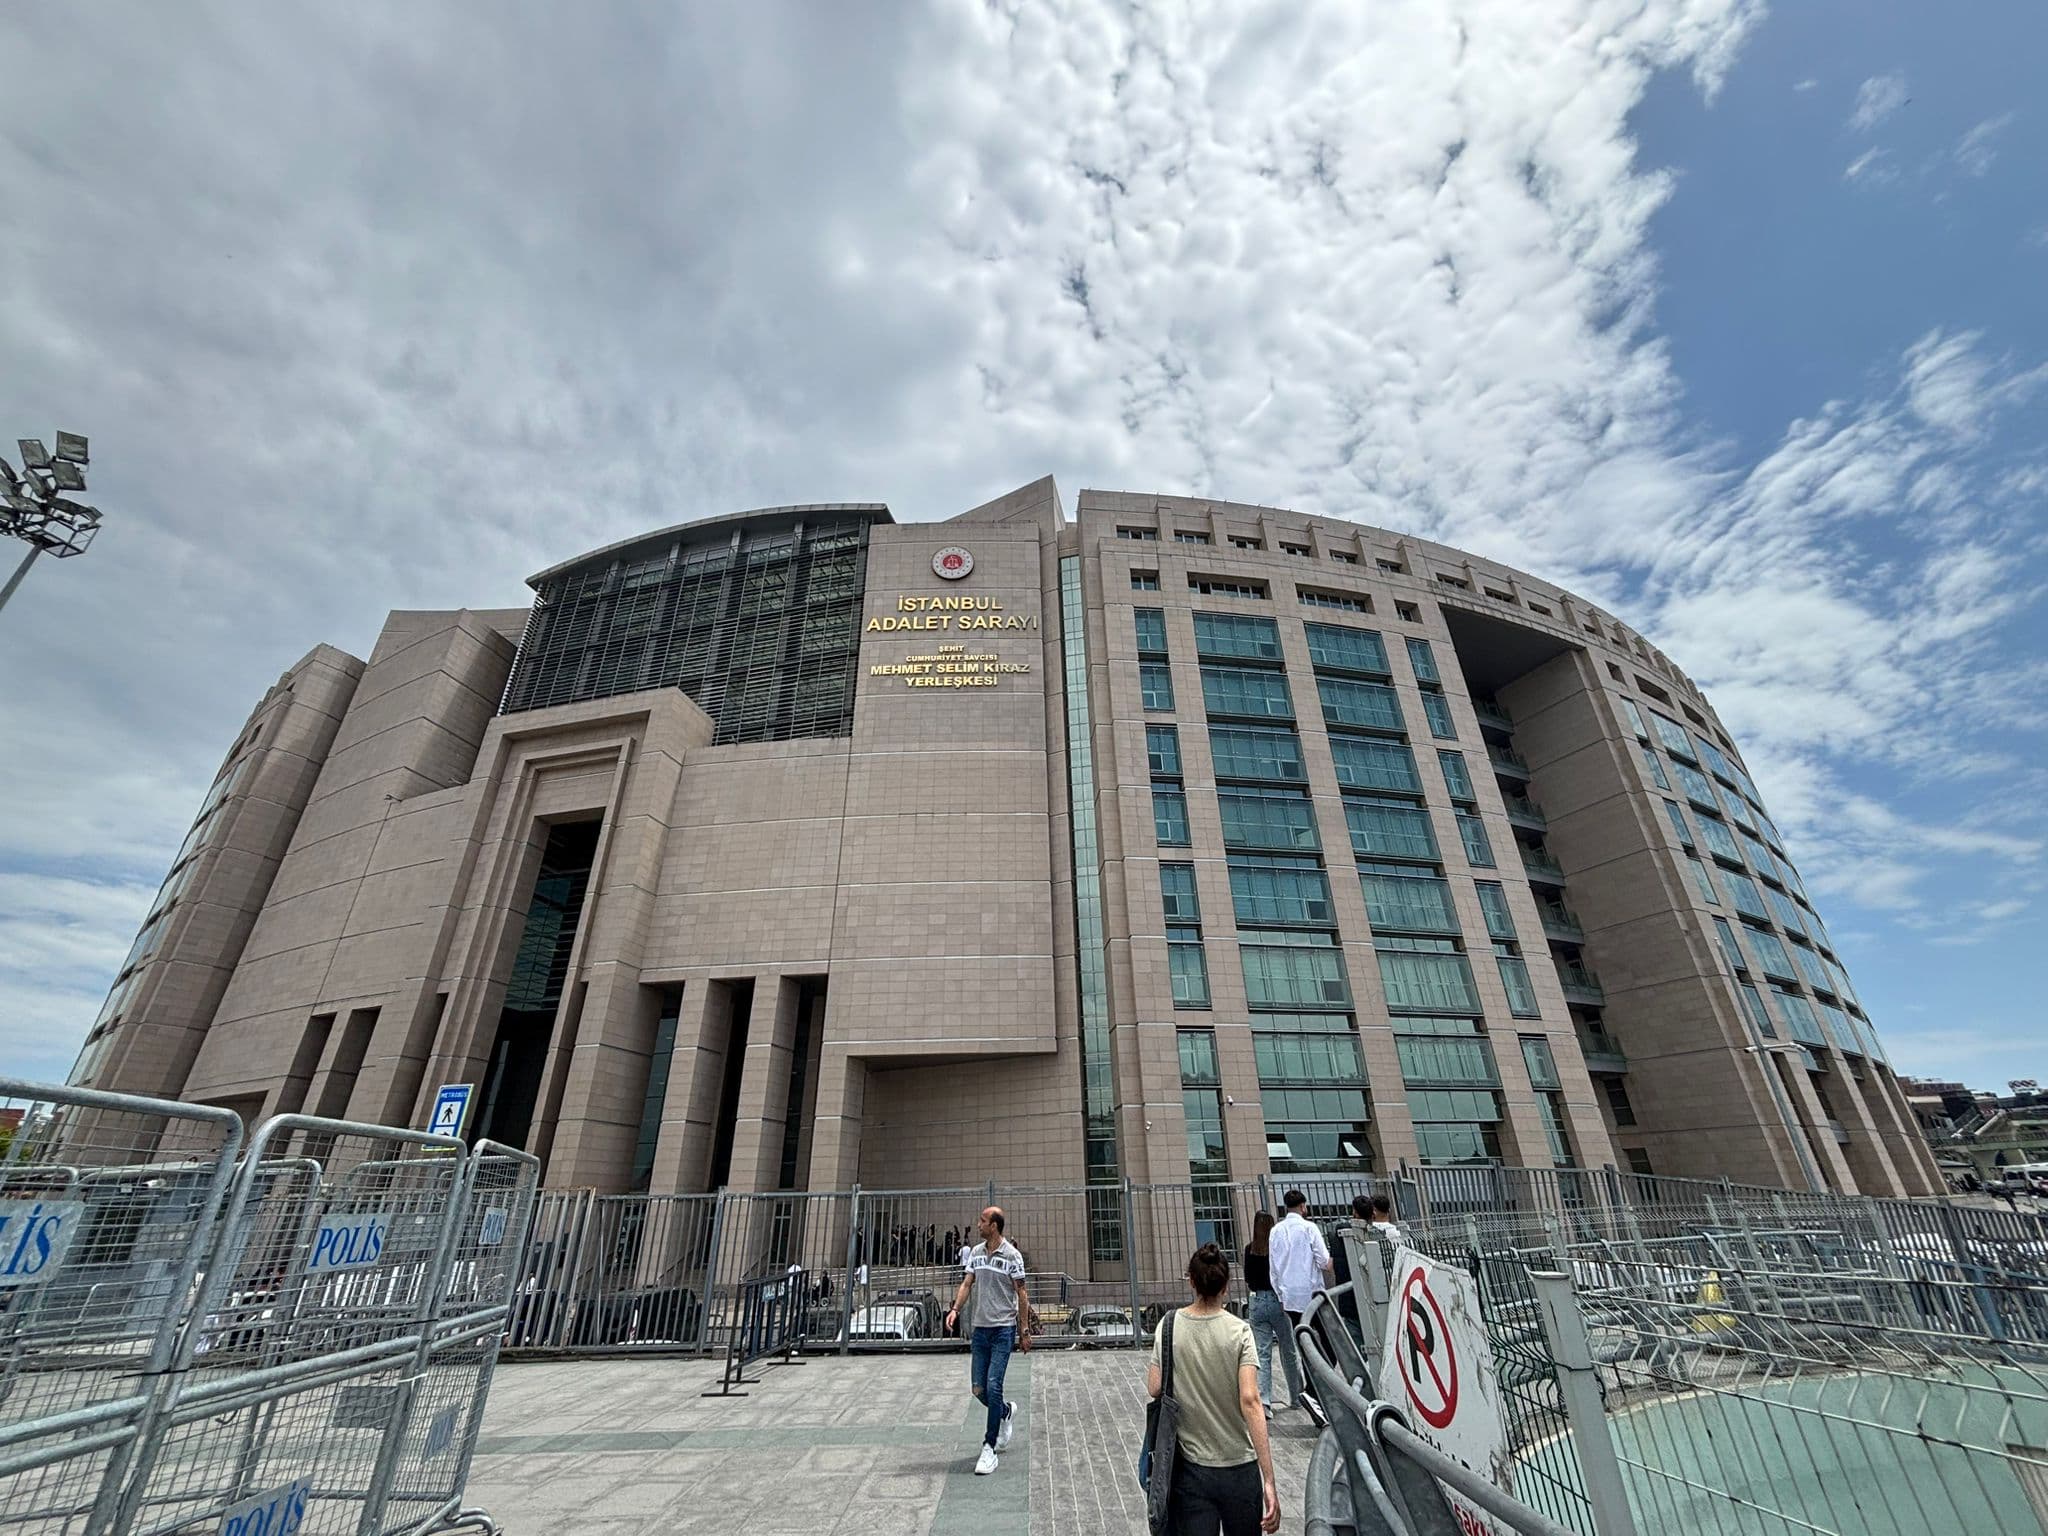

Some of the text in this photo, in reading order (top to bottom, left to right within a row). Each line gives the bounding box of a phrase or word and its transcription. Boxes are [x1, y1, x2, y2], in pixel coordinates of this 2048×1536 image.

[898, 594, 1003, 611] İSTANBUL
[866, 615, 1037, 632] ADALET SARAYI
[870, 664, 932, 675] MEHMET
[936, 661, 979, 673] SELİM
[905, 675, 997, 689] YERLEŞKESİ
[309, 1218, 385, 1267] POLİS
